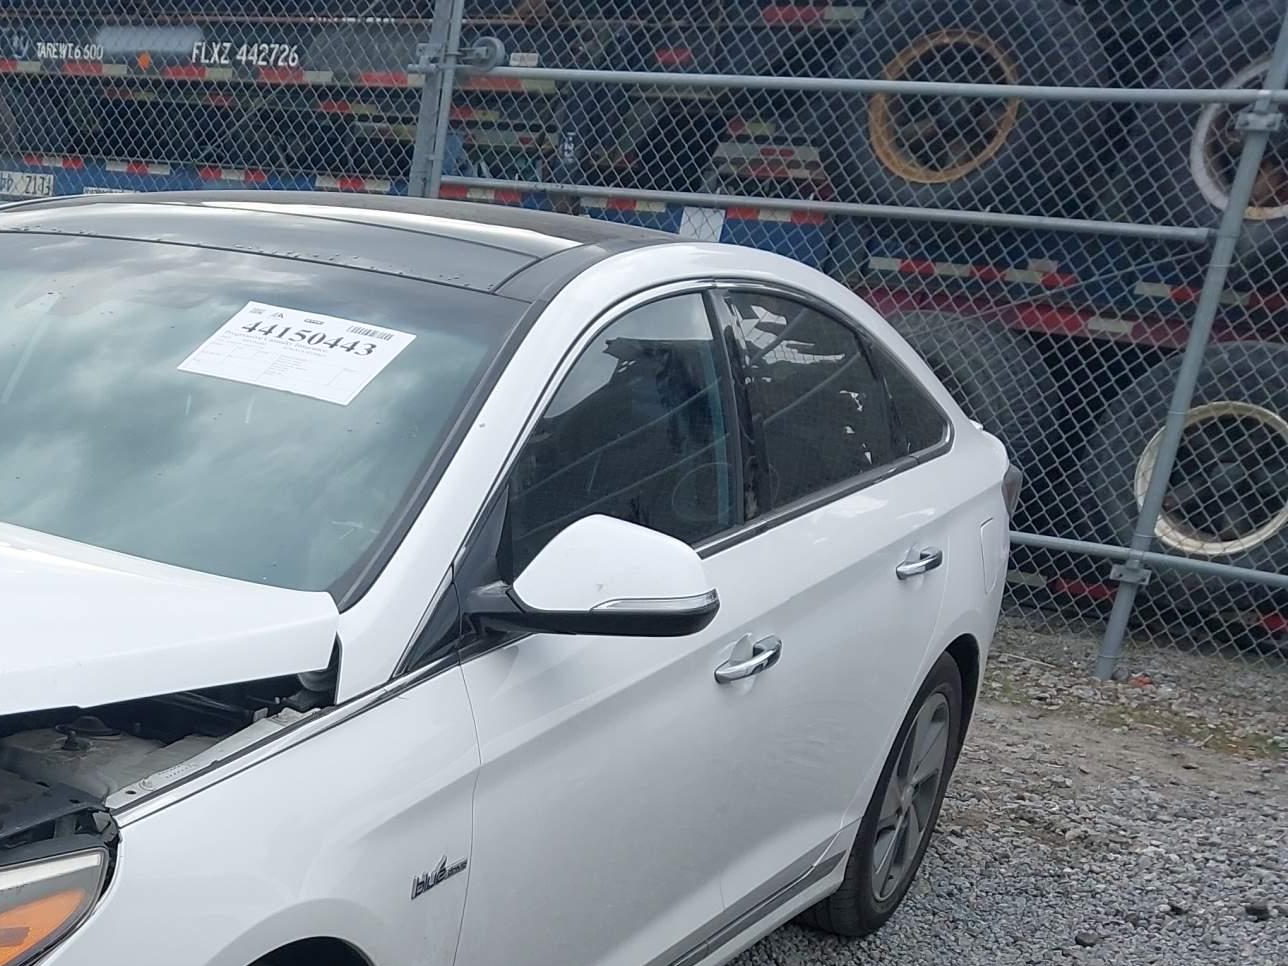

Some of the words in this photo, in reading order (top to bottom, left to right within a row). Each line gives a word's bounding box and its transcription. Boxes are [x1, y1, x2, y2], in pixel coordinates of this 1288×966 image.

[192, 41, 232, 65] FLXZ
[236, 43, 300, 67] 442726
[241, 321, 377, 356] 44150443
